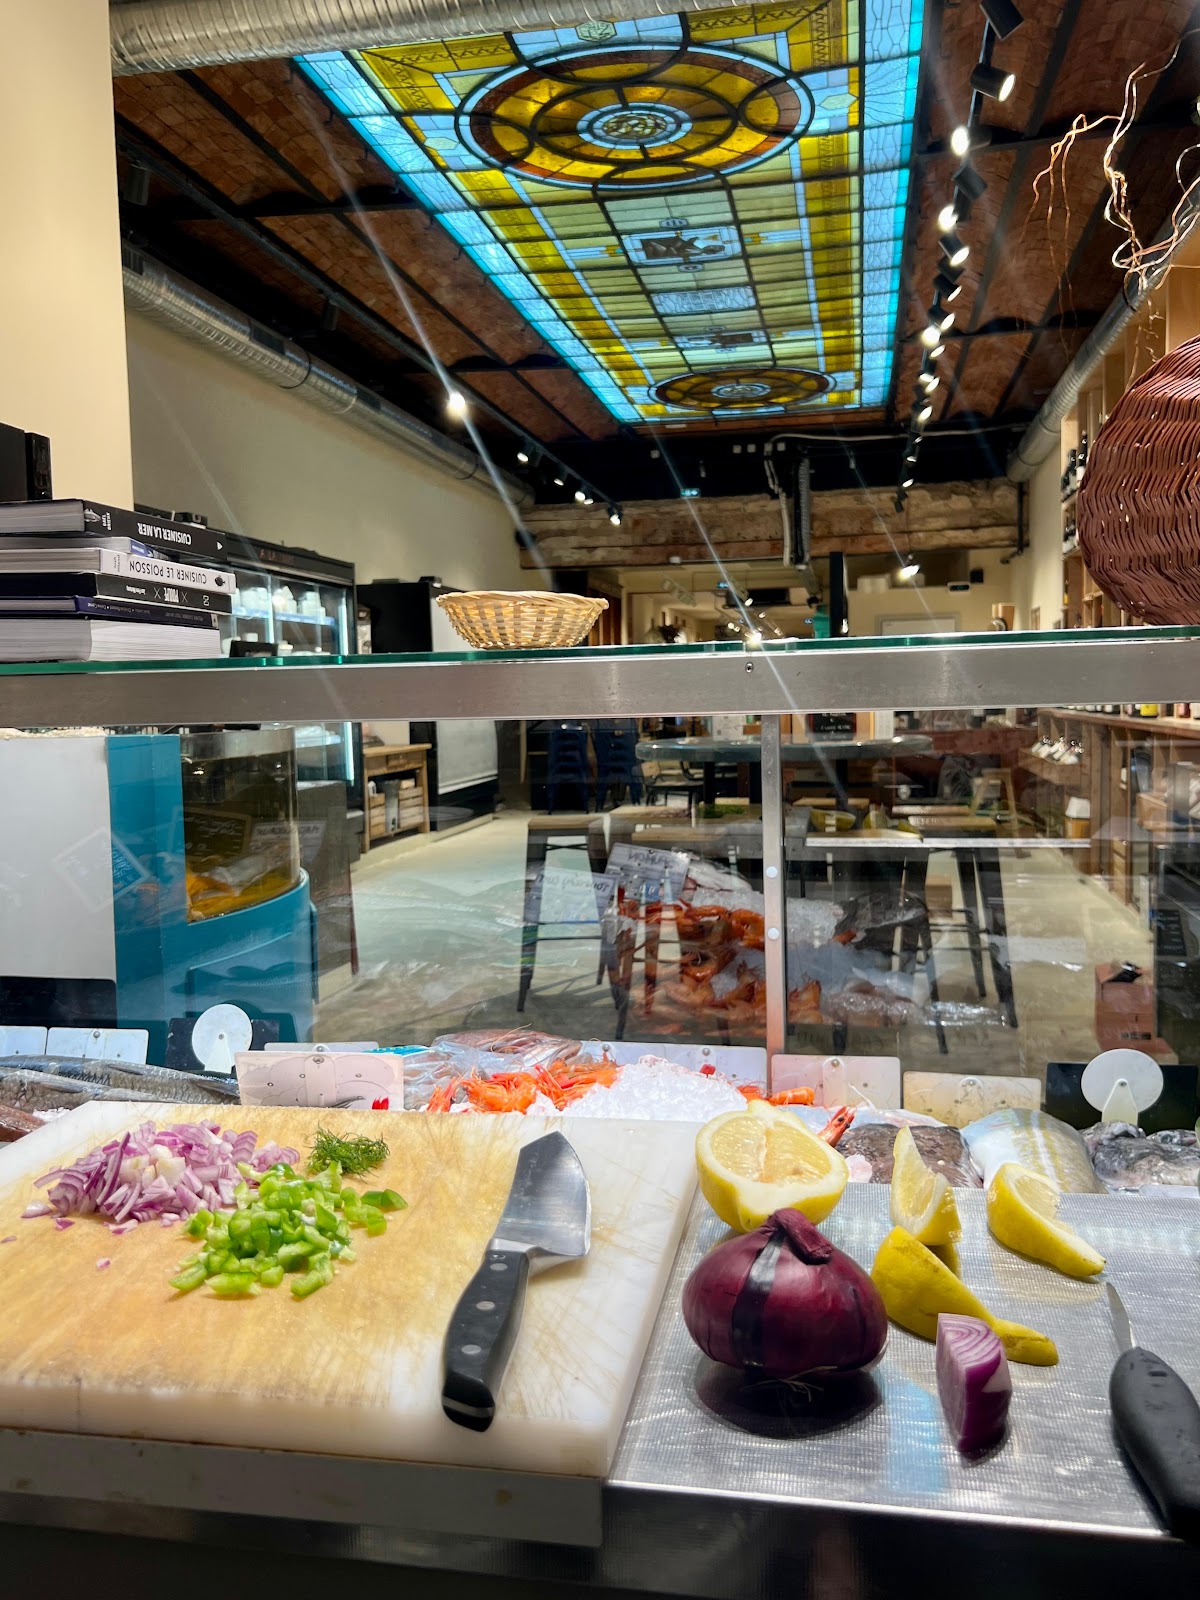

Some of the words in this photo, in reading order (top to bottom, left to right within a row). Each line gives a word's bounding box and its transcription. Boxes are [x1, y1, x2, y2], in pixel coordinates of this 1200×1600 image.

[137, 522, 152, 536] MER
[153, 526, 163, 539] LA
[163, 529, 192, 546] CUISINER
[129, 560, 164, 577] POISSON
[166, 568, 175, 579] LE
[177, 572, 207, 584] CUISINER
